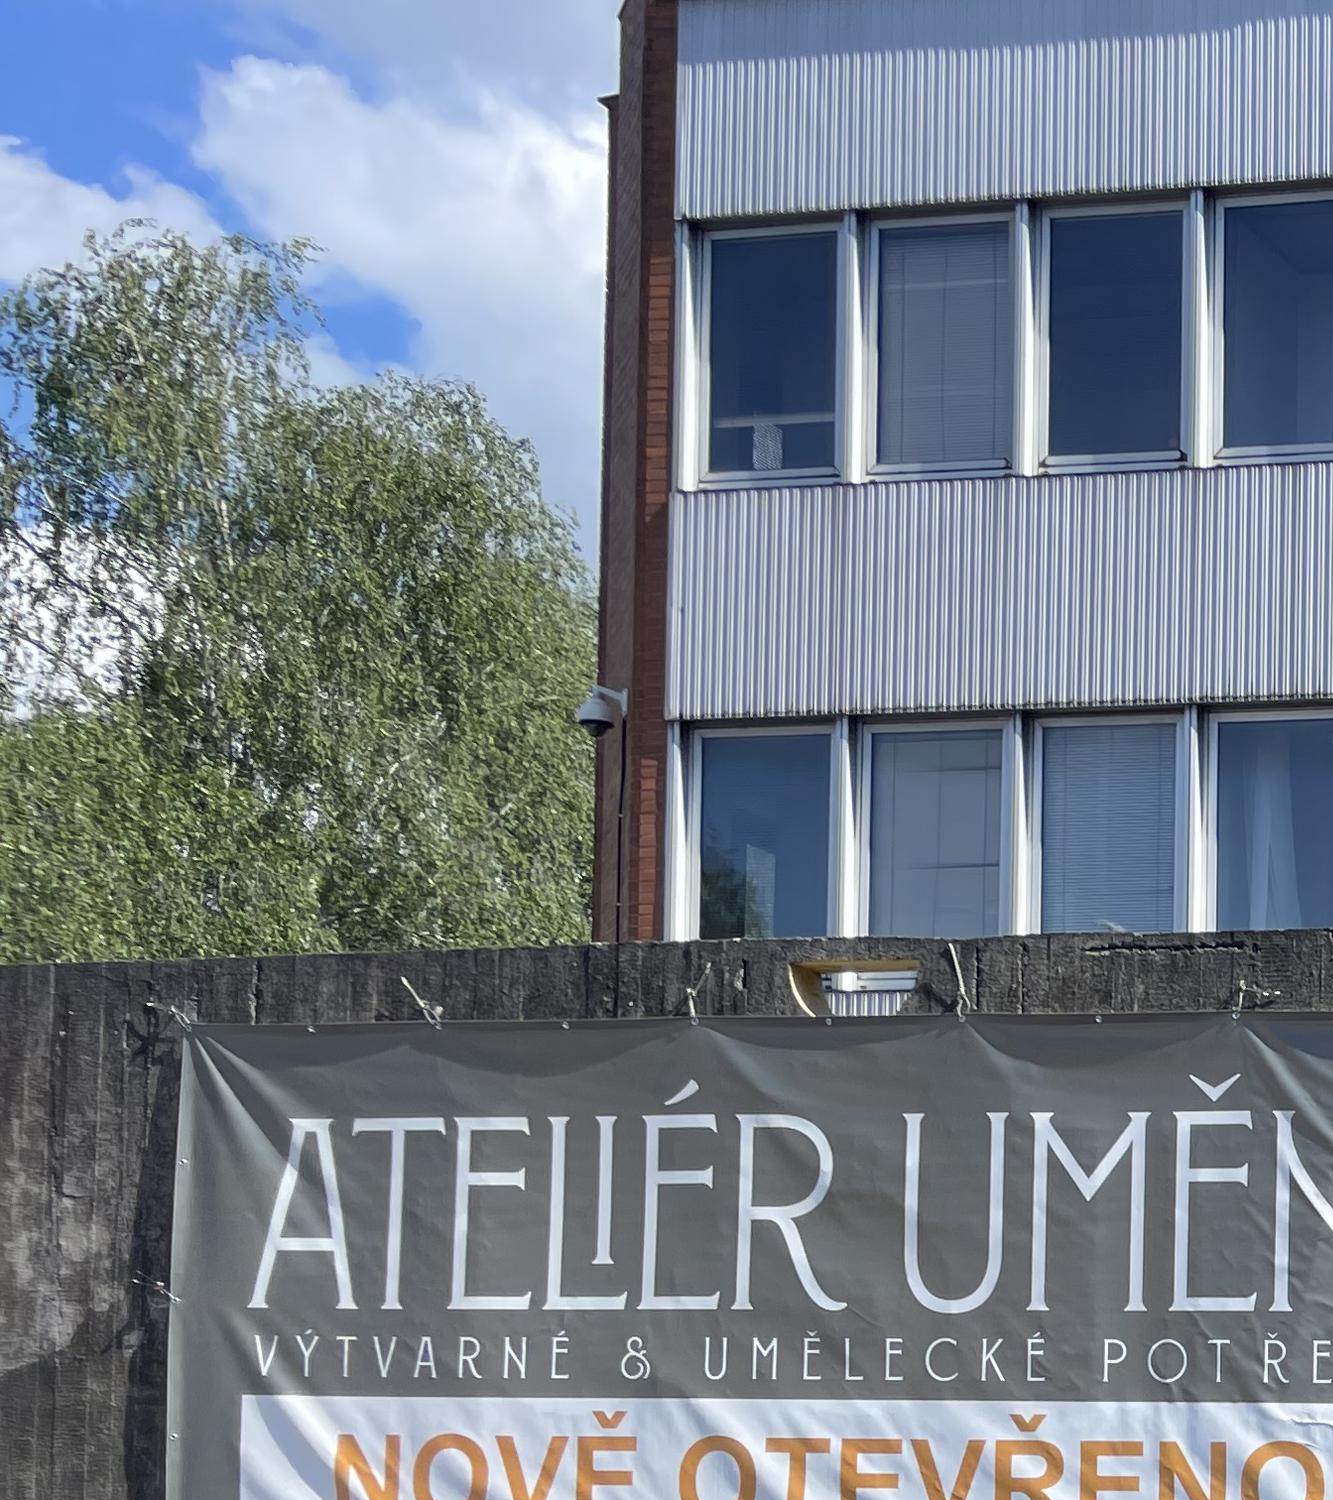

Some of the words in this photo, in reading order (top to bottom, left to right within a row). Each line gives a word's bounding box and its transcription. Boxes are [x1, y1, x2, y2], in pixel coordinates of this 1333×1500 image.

[247, 1079, 848, 1312] ATELIÉR
[253, 1328, 571, 1380] VÝTVARNÉ
[620, 1336, 651, 1381] &
[704, 1329, 1047, 1383] UMĚLECKÉ
